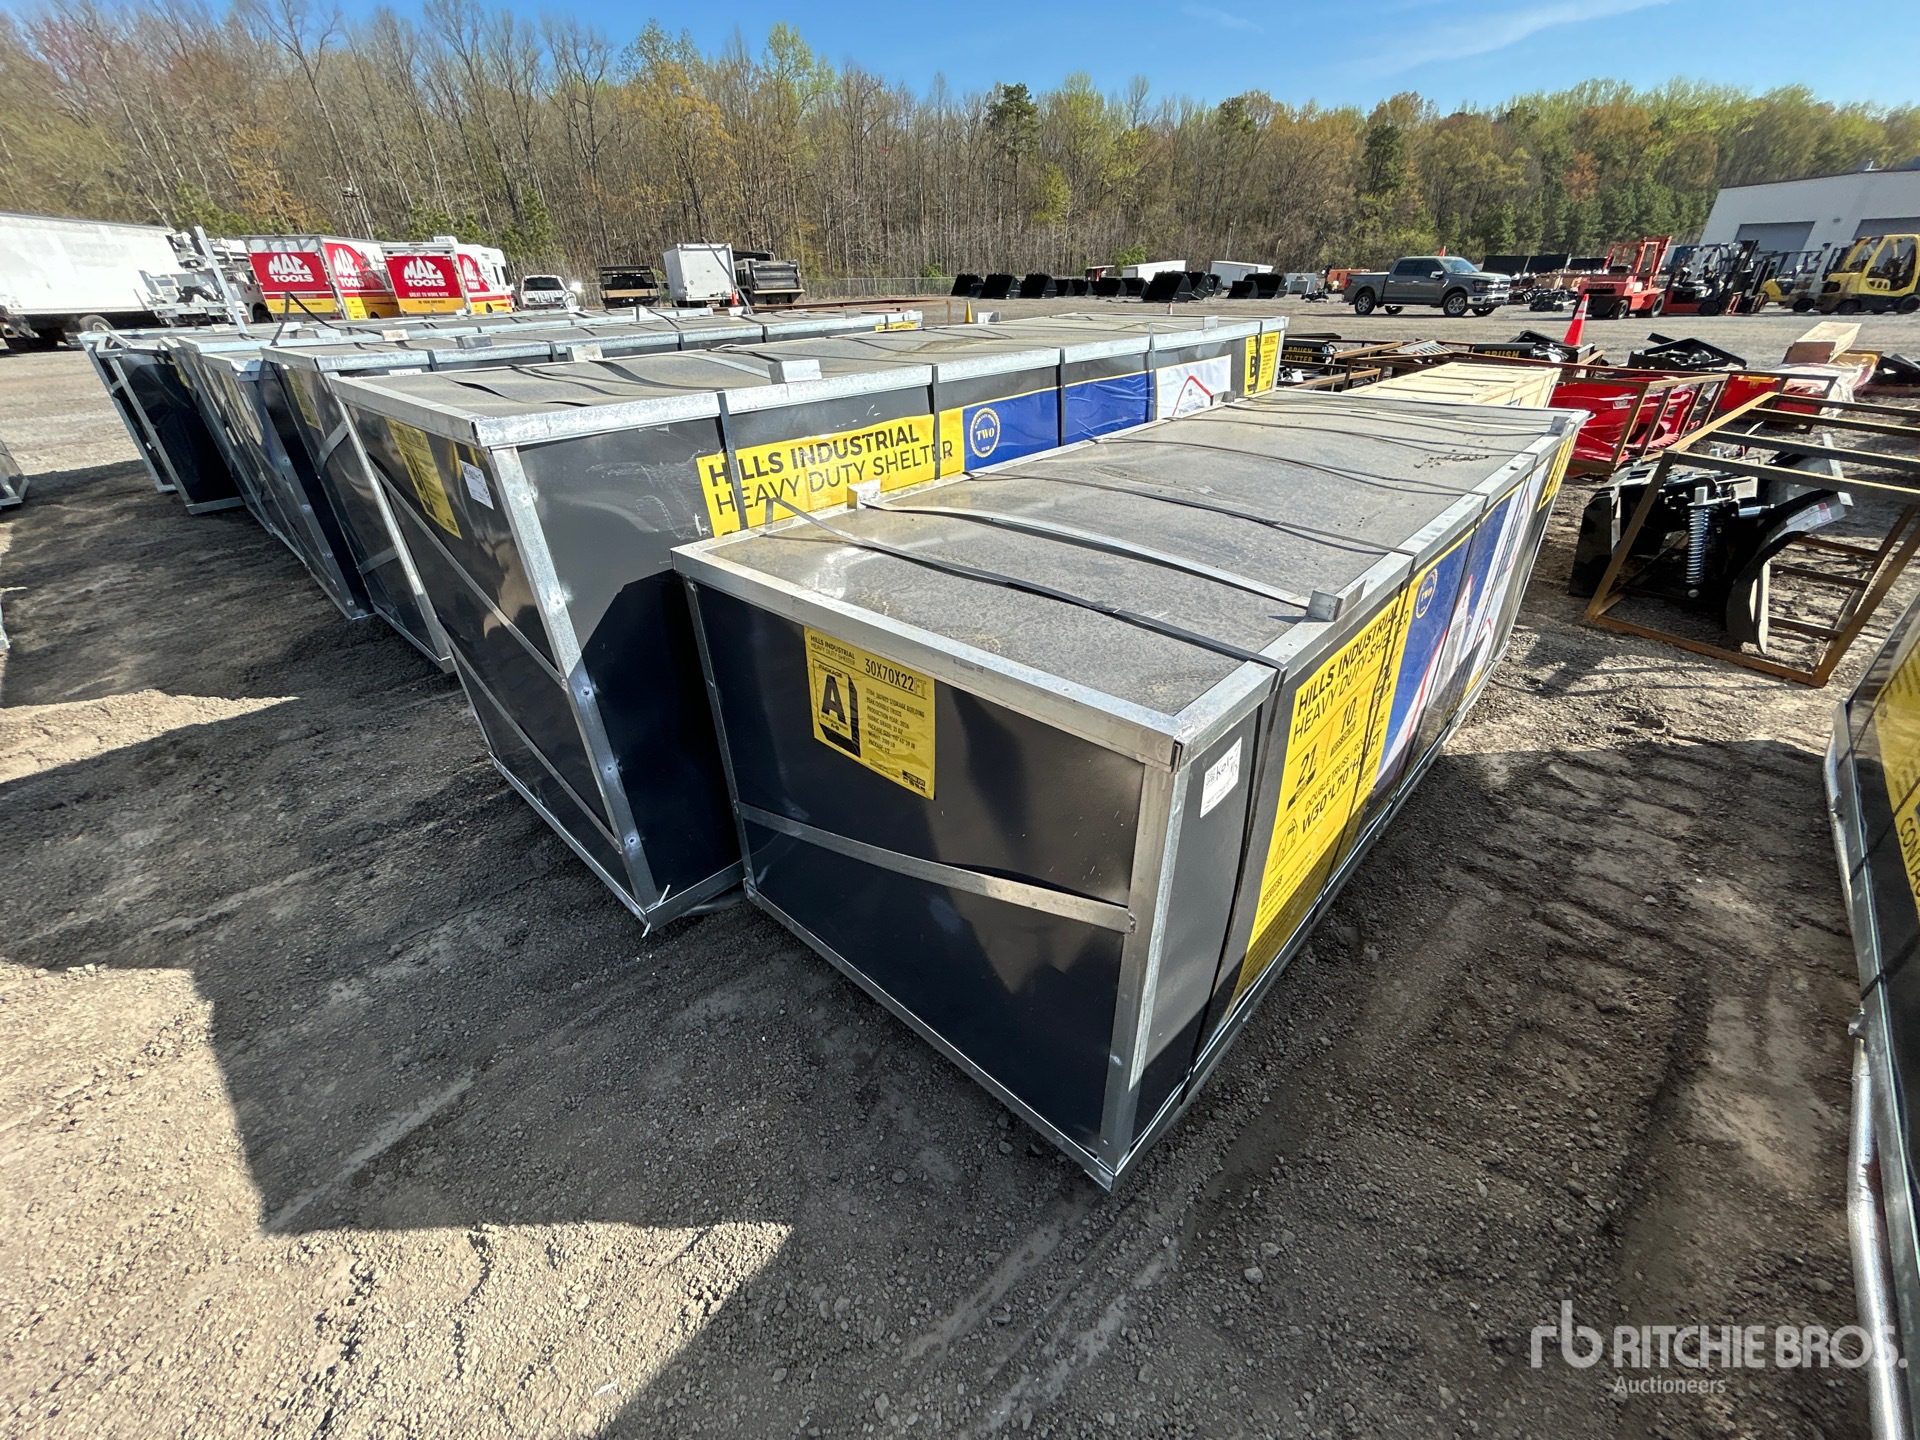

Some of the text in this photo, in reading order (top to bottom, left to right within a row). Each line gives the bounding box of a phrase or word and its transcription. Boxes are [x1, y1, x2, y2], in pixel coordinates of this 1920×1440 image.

[269, 253, 312, 274] MAC
[334, 247, 362, 276] MAC
[404, 256, 444, 279] MAC
[270, 275, 315, 283] TOOLS
[338, 277, 365, 288] TOOLS
[405, 279, 446, 288] TOOLS
[976, 427, 995, 441] TWO
[709, 424, 920, 487] HLLS INDUSTRIAL
[808, 459, 866, 493] DUTY
[810, 635, 855, 660] HILLS INDUSTRIAL
[821, 674, 847, 725] A
[1293, 683, 1339, 745] HEAVY
[1338, 650, 1368, 698] DUTY
[1297, 663, 1336, 717] HILLS
[1341, 696, 1357, 734] 10
[1296, 742, 1318, 789] 21
